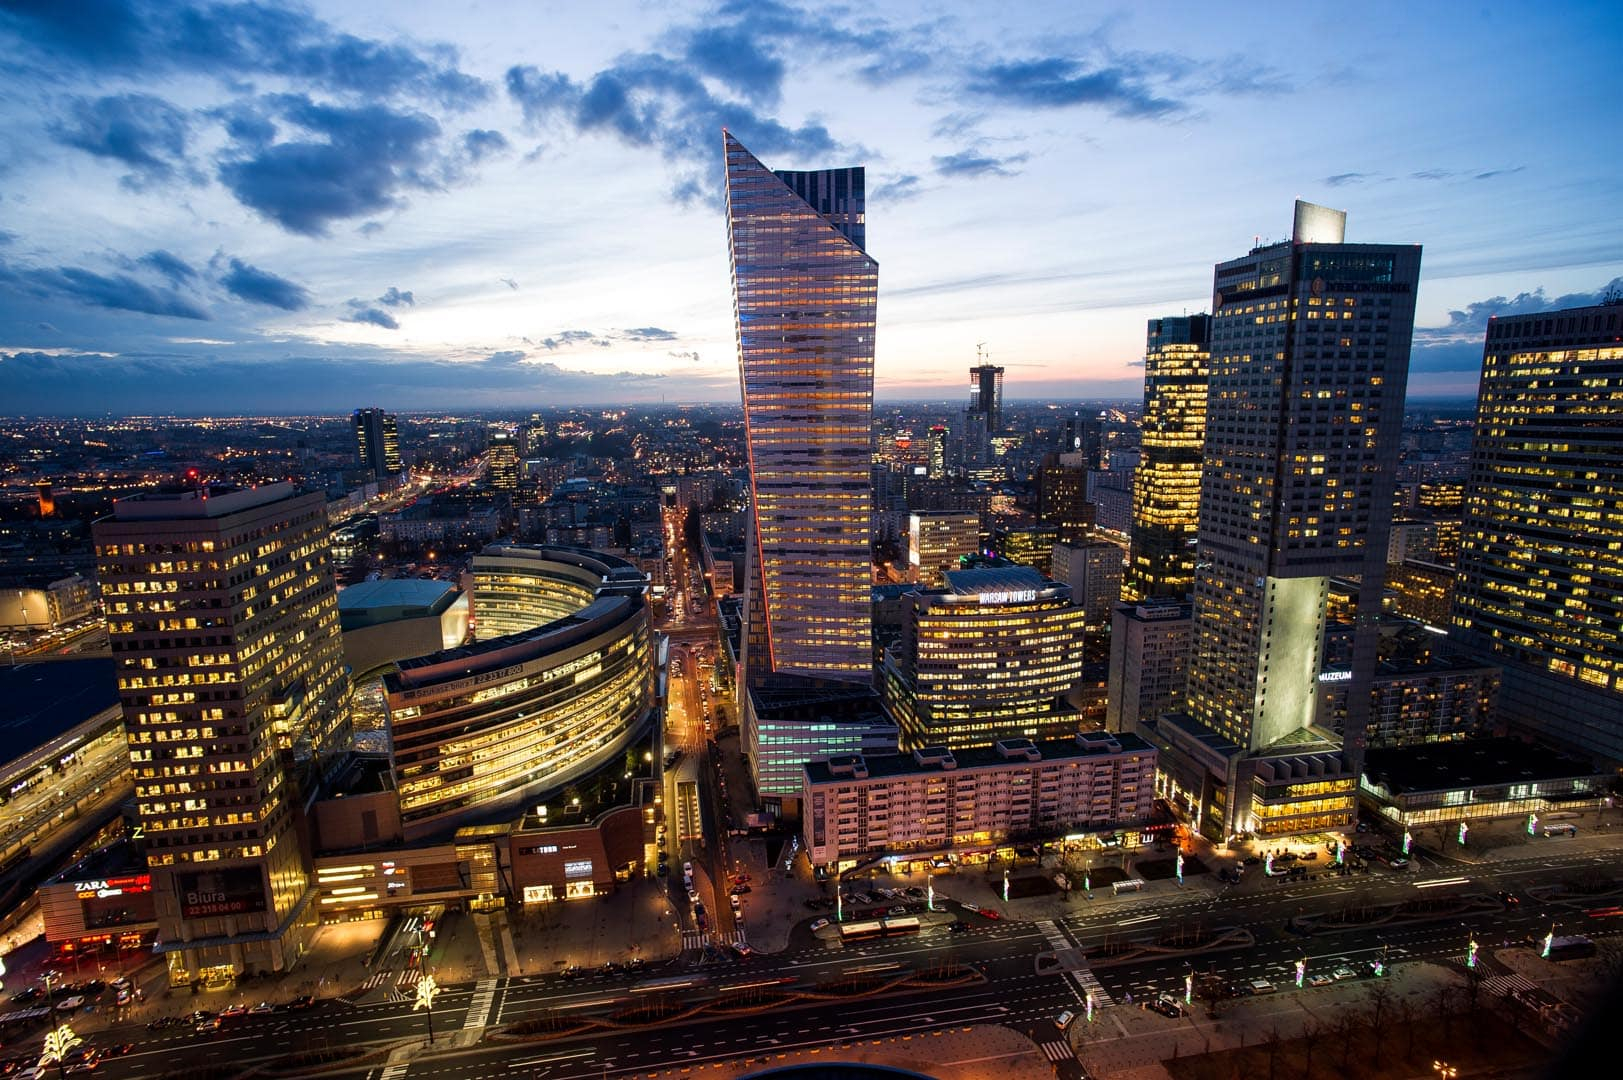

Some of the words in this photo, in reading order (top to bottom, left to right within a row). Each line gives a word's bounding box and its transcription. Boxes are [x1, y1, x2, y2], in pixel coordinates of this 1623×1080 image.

[979, 592, 1008, 604] WARSAW
[1009, 590, 1036, 602] TOWERS
[75, 880, 109, 891] ZARA
[187, 891, 226, 905] Biura
[189, 905, 201, 915] 22
